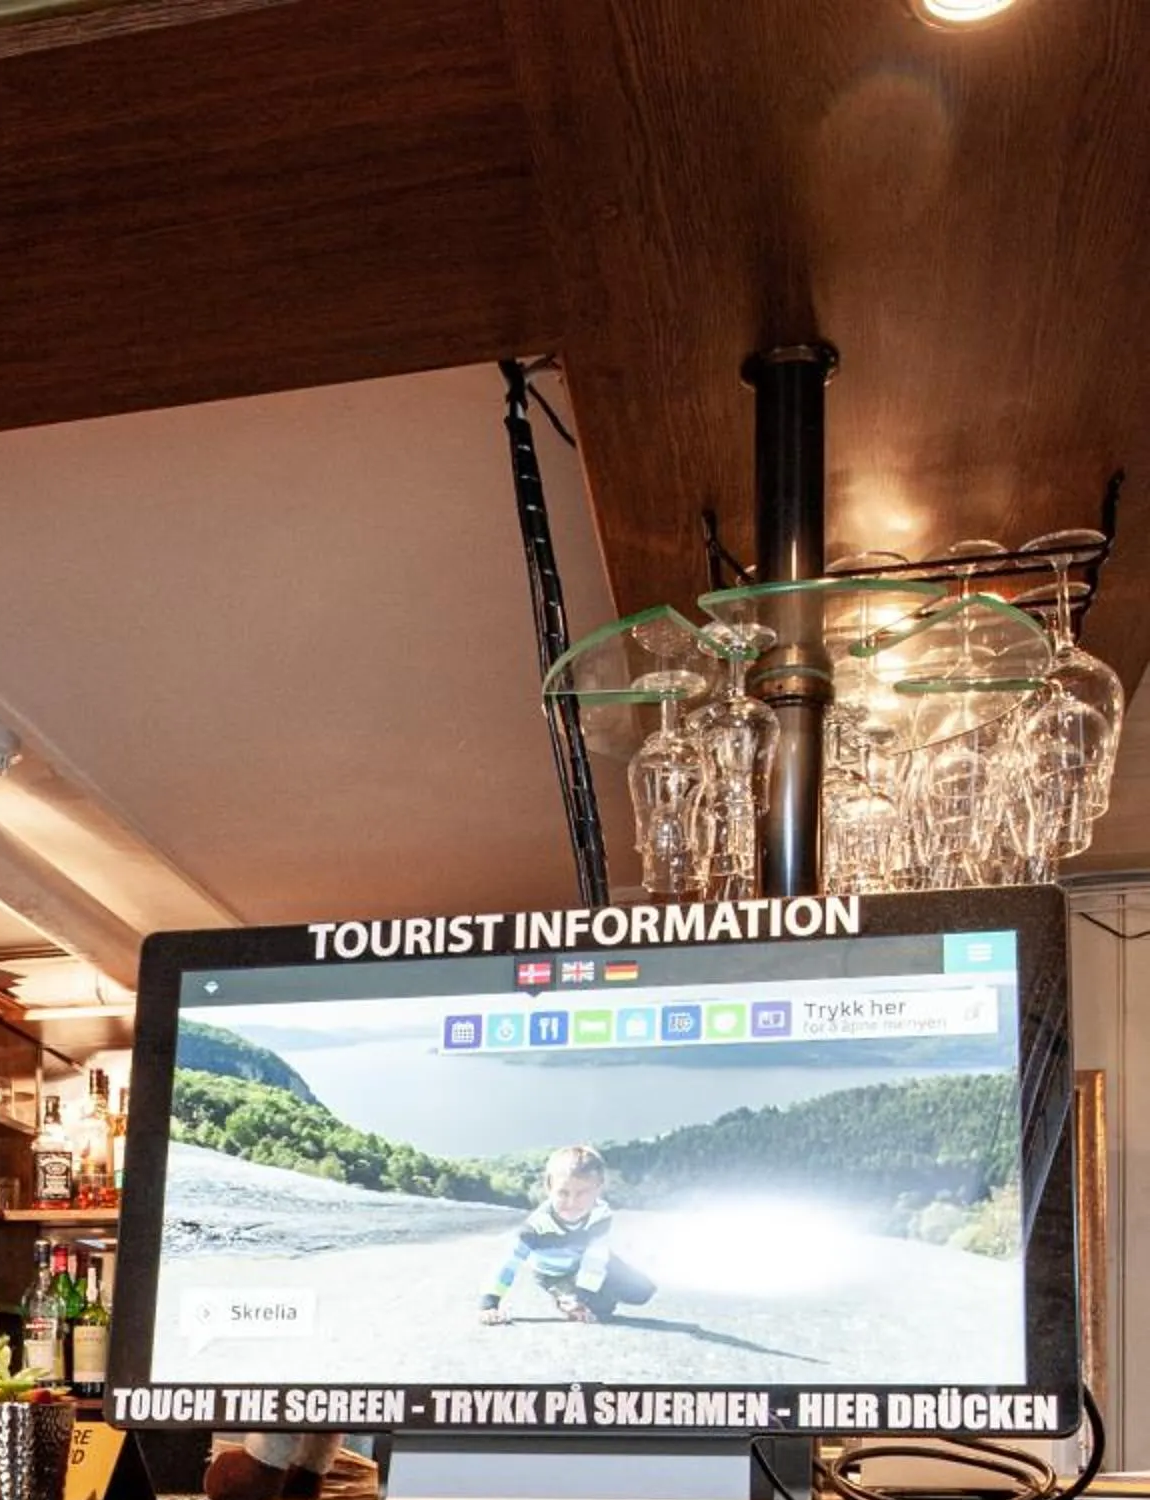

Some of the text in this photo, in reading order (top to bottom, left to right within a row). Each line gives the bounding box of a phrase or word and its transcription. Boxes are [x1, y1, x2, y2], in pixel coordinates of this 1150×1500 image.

[308, 896, 859, 960] TOURIST INFORMATION
[804, 1000, 906, 1021] Trykk her
[231, 1303, 297, 1321] Skrelia
[113, 1387, 215, 1421] TOUCH
[222, 1389, 278, 1422] THE
[285, 1389, 405, 1423] SCREEN
[432, 1390, 538, 1424] TRYKK
[545, 1384, 588, 1425] PÅ
[594, 1391, 770, 1427] SKJERMEN
[799, 1392, 879, 1428] HIER
[887, 1387, 1058, 1431] DRÜCKEN
